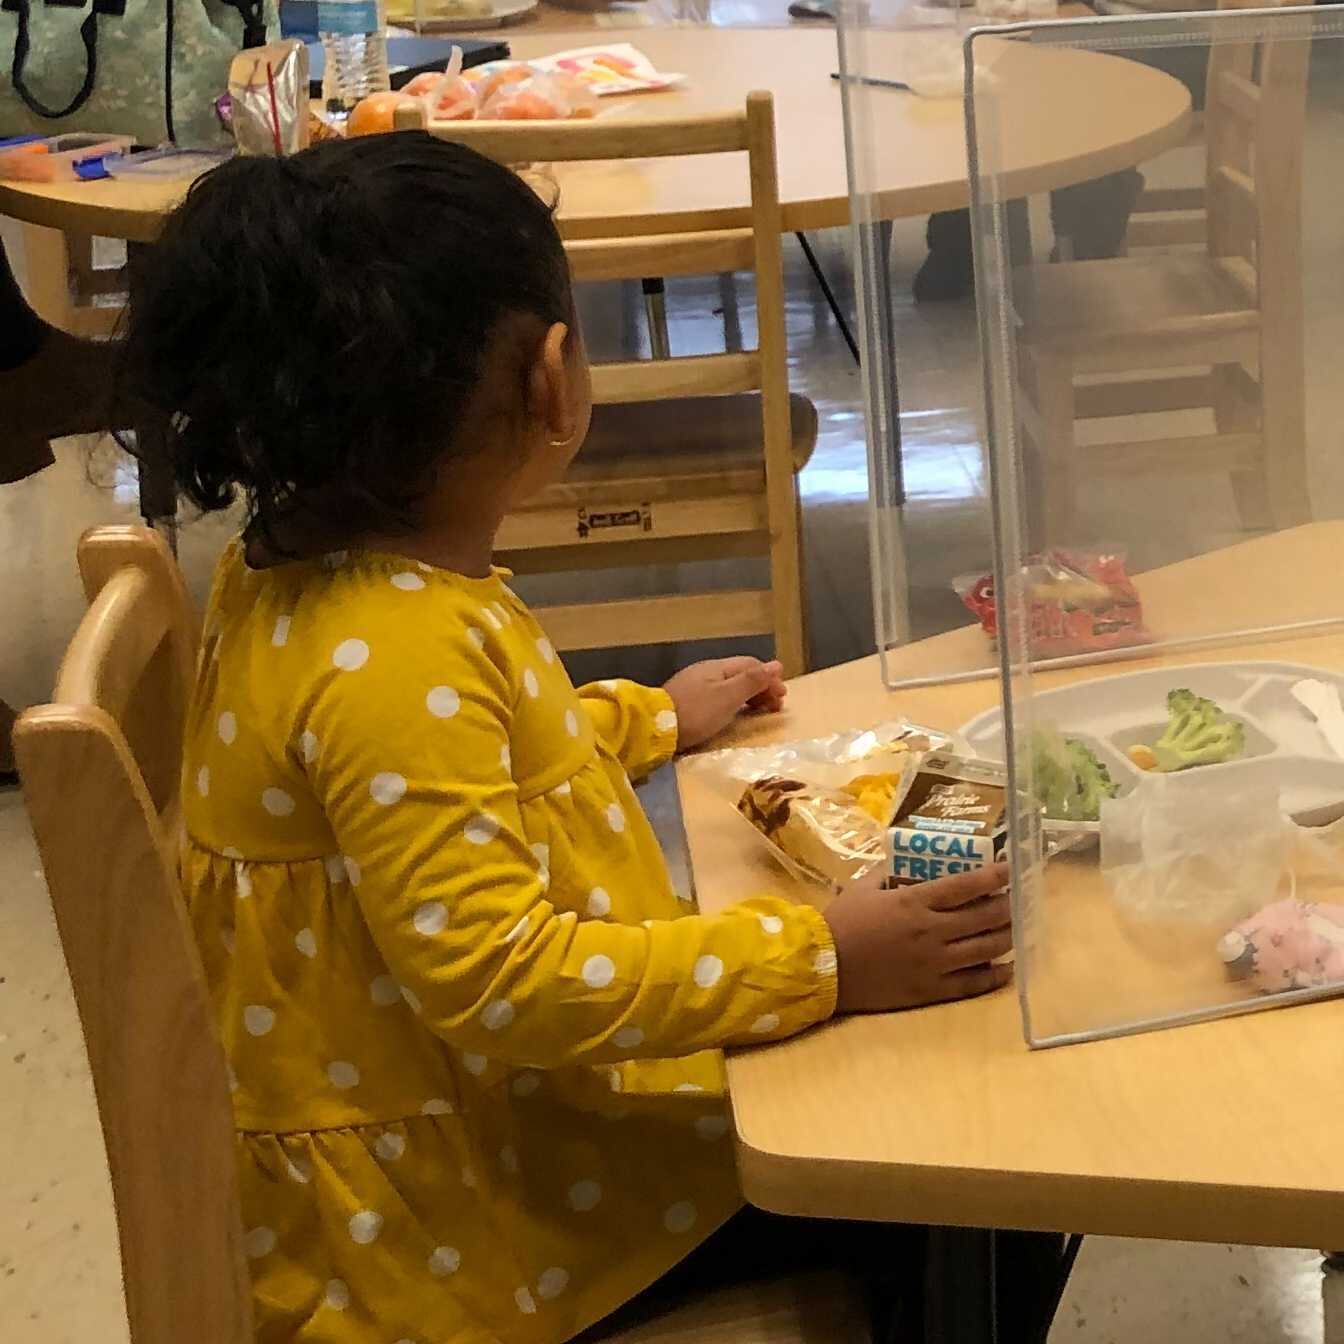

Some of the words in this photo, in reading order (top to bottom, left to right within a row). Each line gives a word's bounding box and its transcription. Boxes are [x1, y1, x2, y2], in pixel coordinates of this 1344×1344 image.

[920, 793, 981, 812] Prairie
[894, 831, 984, 858] LOCAL
[894, 855, 984, 881] FRES
